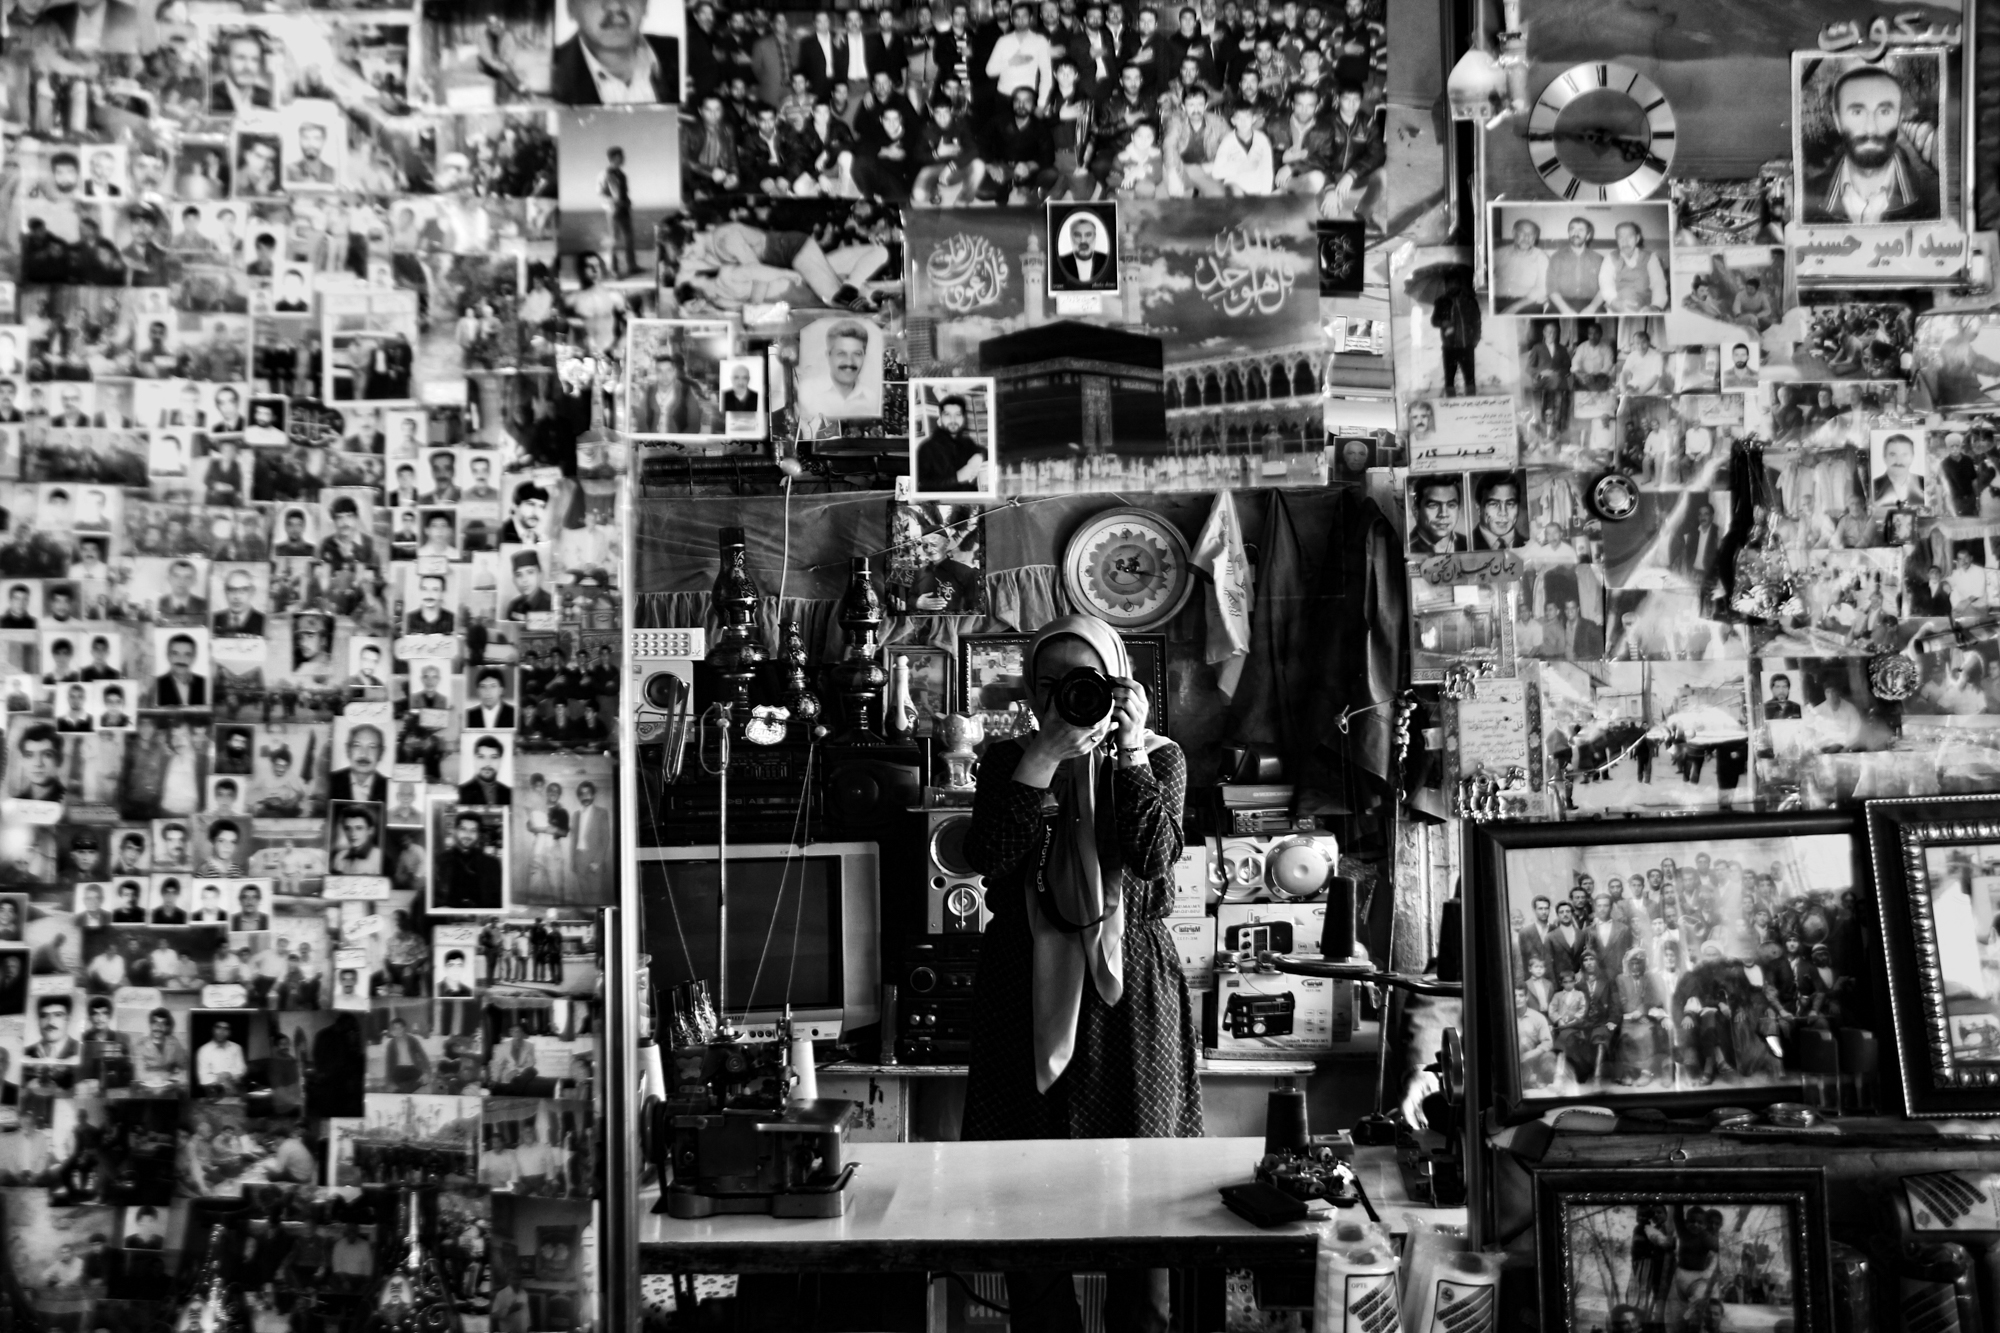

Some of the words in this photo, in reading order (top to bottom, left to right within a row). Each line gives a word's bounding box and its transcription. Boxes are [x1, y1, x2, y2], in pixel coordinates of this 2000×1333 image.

[1867, 227, 1913, 268] امیر
[1918, 231, 1963, 266] سید
[1416, 445, 1496, 460] خبرنگار
[1489, 558, 1516, 576] جهان
